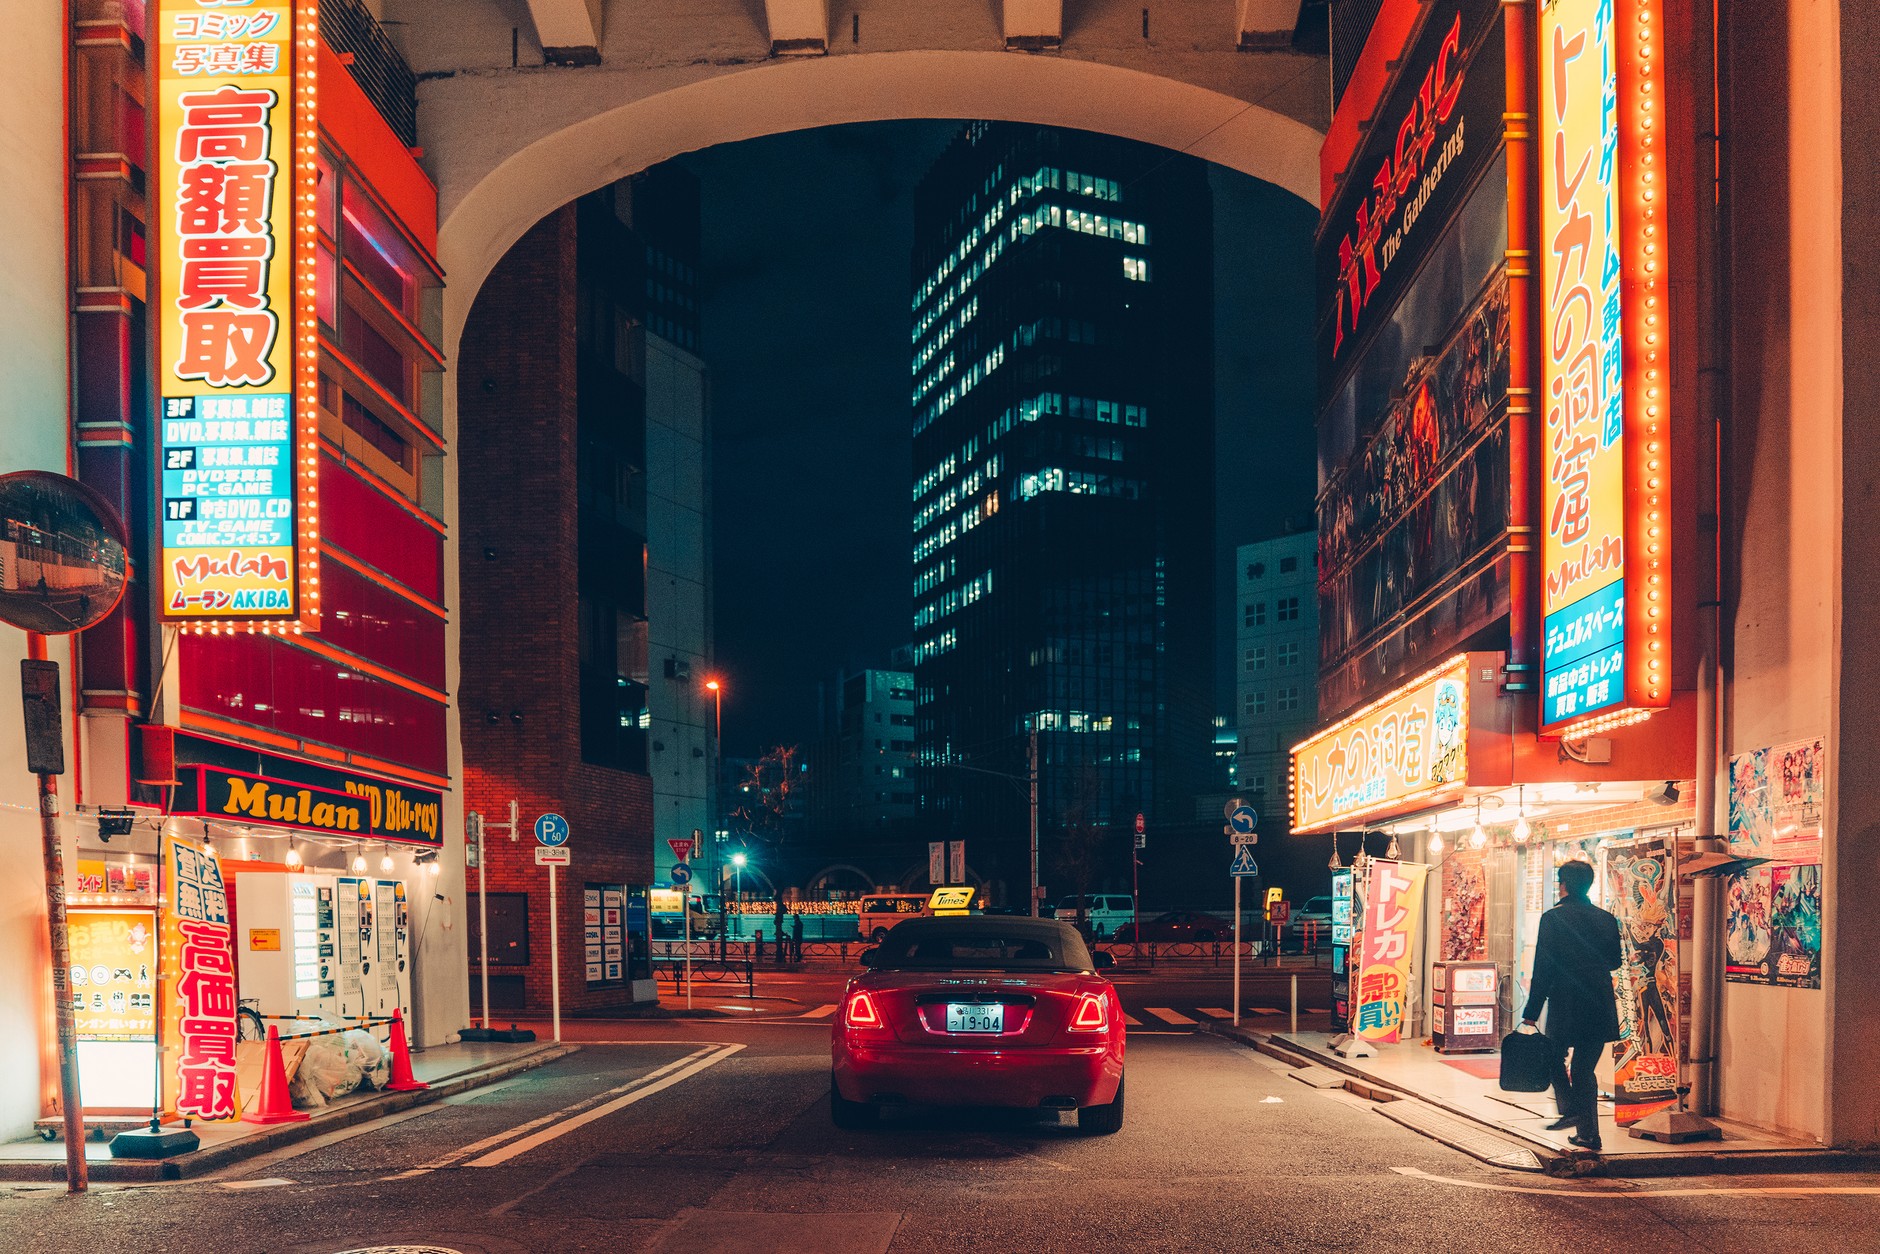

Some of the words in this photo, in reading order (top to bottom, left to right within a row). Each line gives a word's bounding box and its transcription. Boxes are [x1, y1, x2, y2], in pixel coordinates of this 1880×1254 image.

[174, 10, 279, 38] コミック
[173, 43, 278, 74] 写真集
[1333, 10, 1464, 361] MAGIC
[1381, 227, 1402, 272] The
[1402, 115, 1465, 236] Gathering
[176, 86, 276, 386] 高額買取
[1548, 23, 1600, 547] トレカの洞窟
[167, 398, 192, 417] 3F
[167, 450, 193, 468] 2F
[182, 482, 272, 495] PC-GAME
[168, 501, 192, 519] 1F
[182, 520, 274, 533] TV-GAME
[172, 550, 289, 587] Mulan
[1547, 536, 1624, 609] Mulan
[170, 590, 231, 610] ムーラン
[232, 589, 291, 609] AKIBA
[1547, 597, 1624, 659] デュエルスペース
[1548, 650, 1622, 697] 新品中古トレカ
[1301, 703, 1428, 823] トレカの洞窟
[223, 777, 360, 831] Mulan
[385, 789, 438, 840] Blu-ray
[542, 821, 556, 841] P
[551, 832, 562, 842] 60
[938, 894, 966, 905] Times
[1374, 869, 1413, 961] トレカ
[179, 921, 236, 1119] 高価買取
[962, 1016, 999, 1030] 19-04
